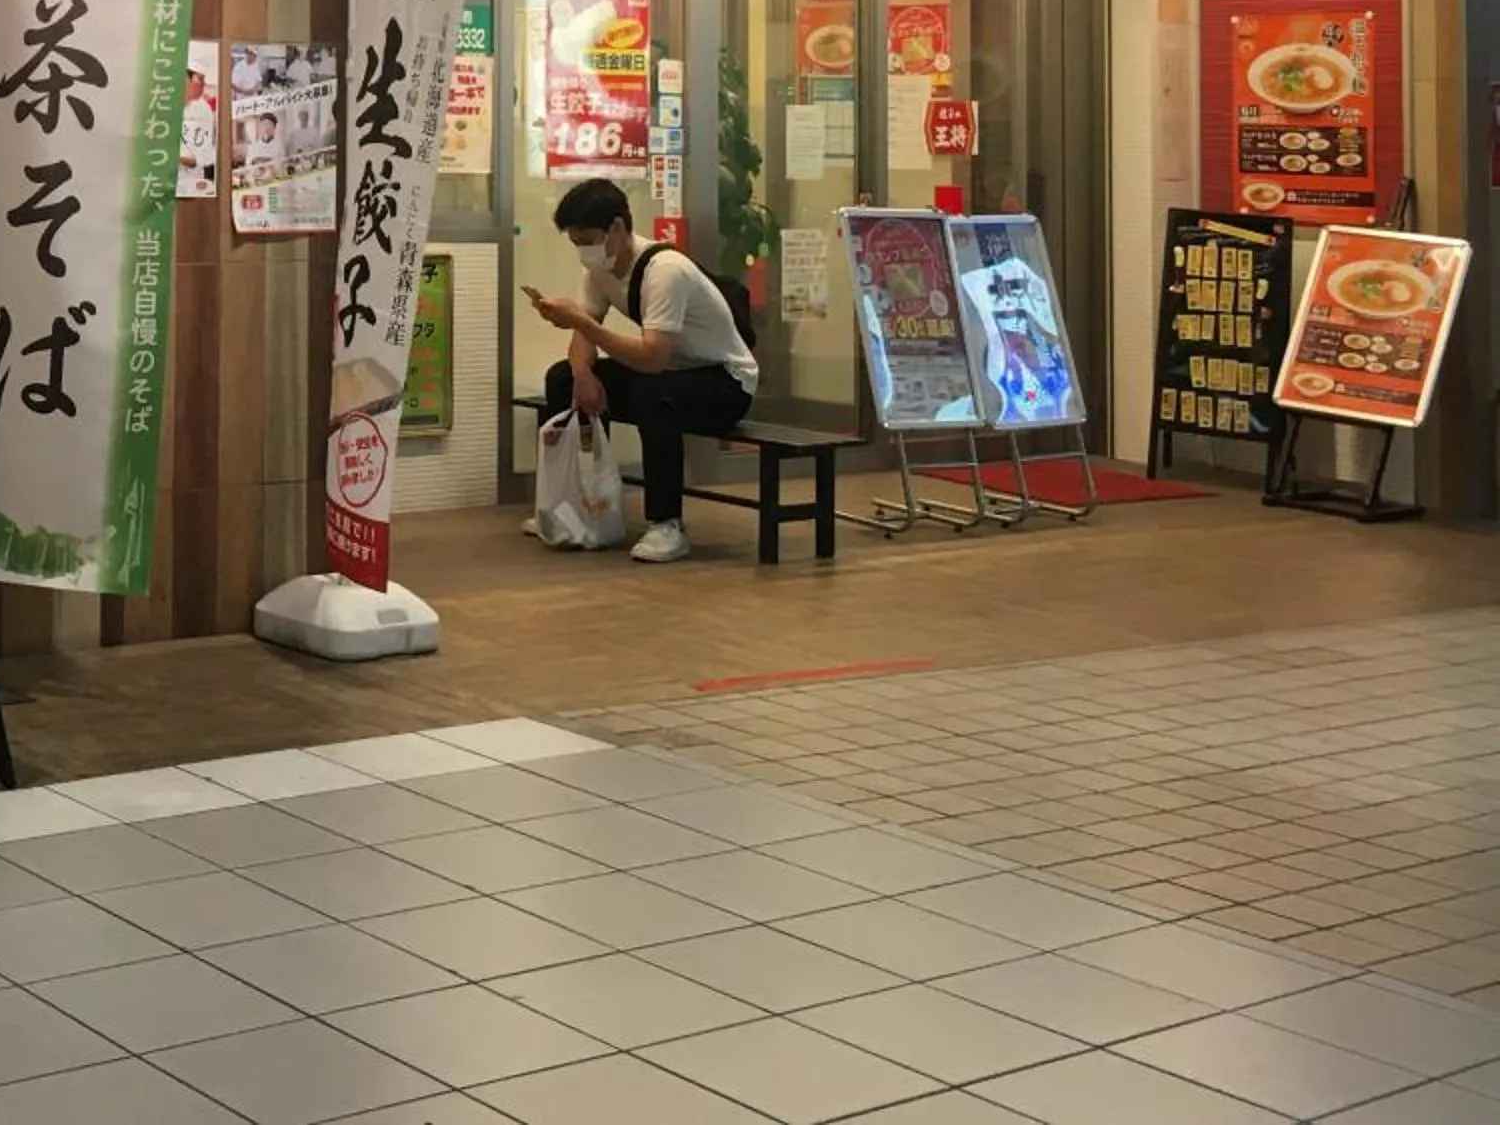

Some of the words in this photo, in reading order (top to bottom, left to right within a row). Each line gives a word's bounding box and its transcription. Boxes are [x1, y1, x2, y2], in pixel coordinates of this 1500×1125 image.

[333, 15, 414, 348] 生餃子
[554, 122, 624, 156] 186
[123, 229, 162, 435] 当店自慢のそば
